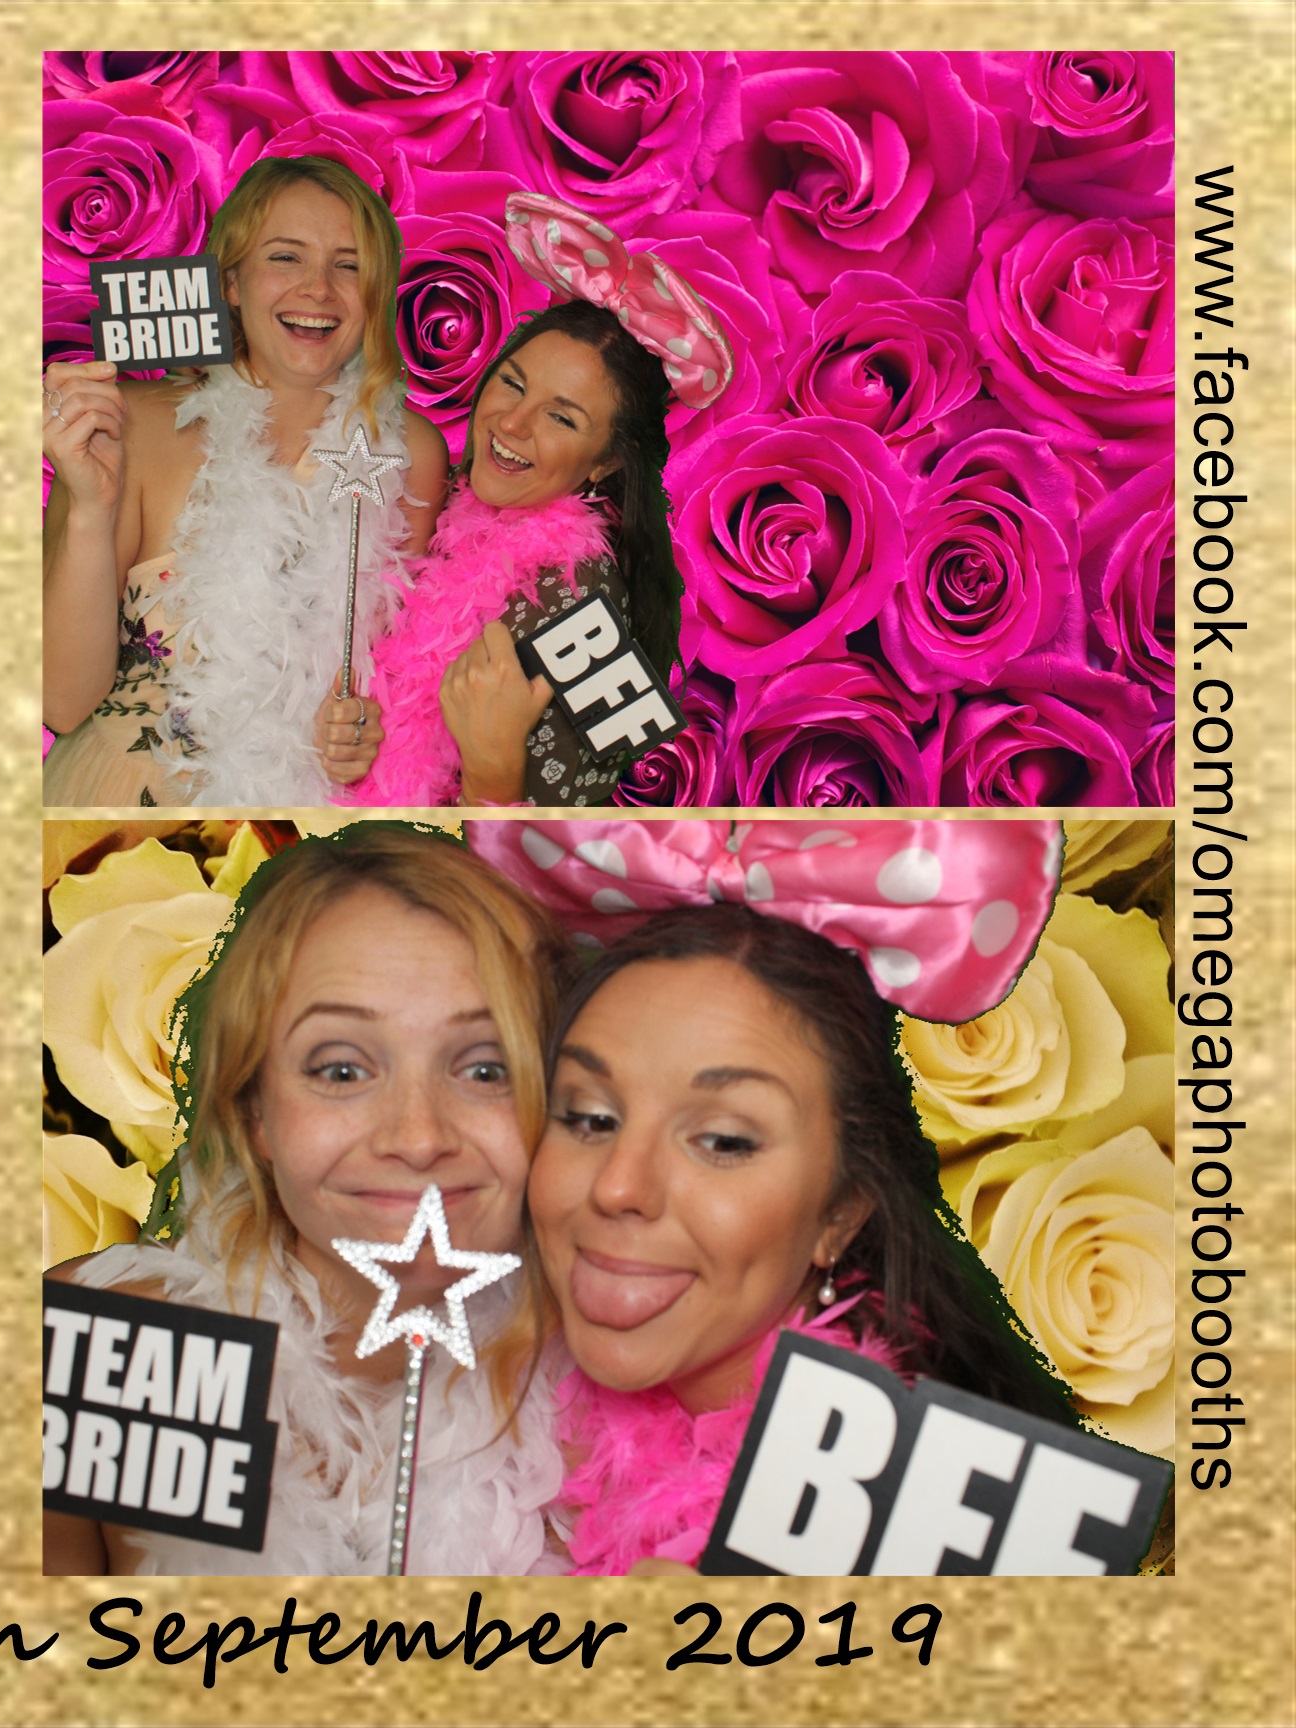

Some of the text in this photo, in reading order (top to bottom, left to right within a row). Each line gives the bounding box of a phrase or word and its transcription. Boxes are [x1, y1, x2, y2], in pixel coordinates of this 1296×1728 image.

[101, 267, 211, 315] TEAM
[101, 313, 223, 362] BRIDE
[531, 597, 677, 753] BFF
[43, 1306, 254, 1430] TEAM
[724, 1351, 1141, 1575] BFF
